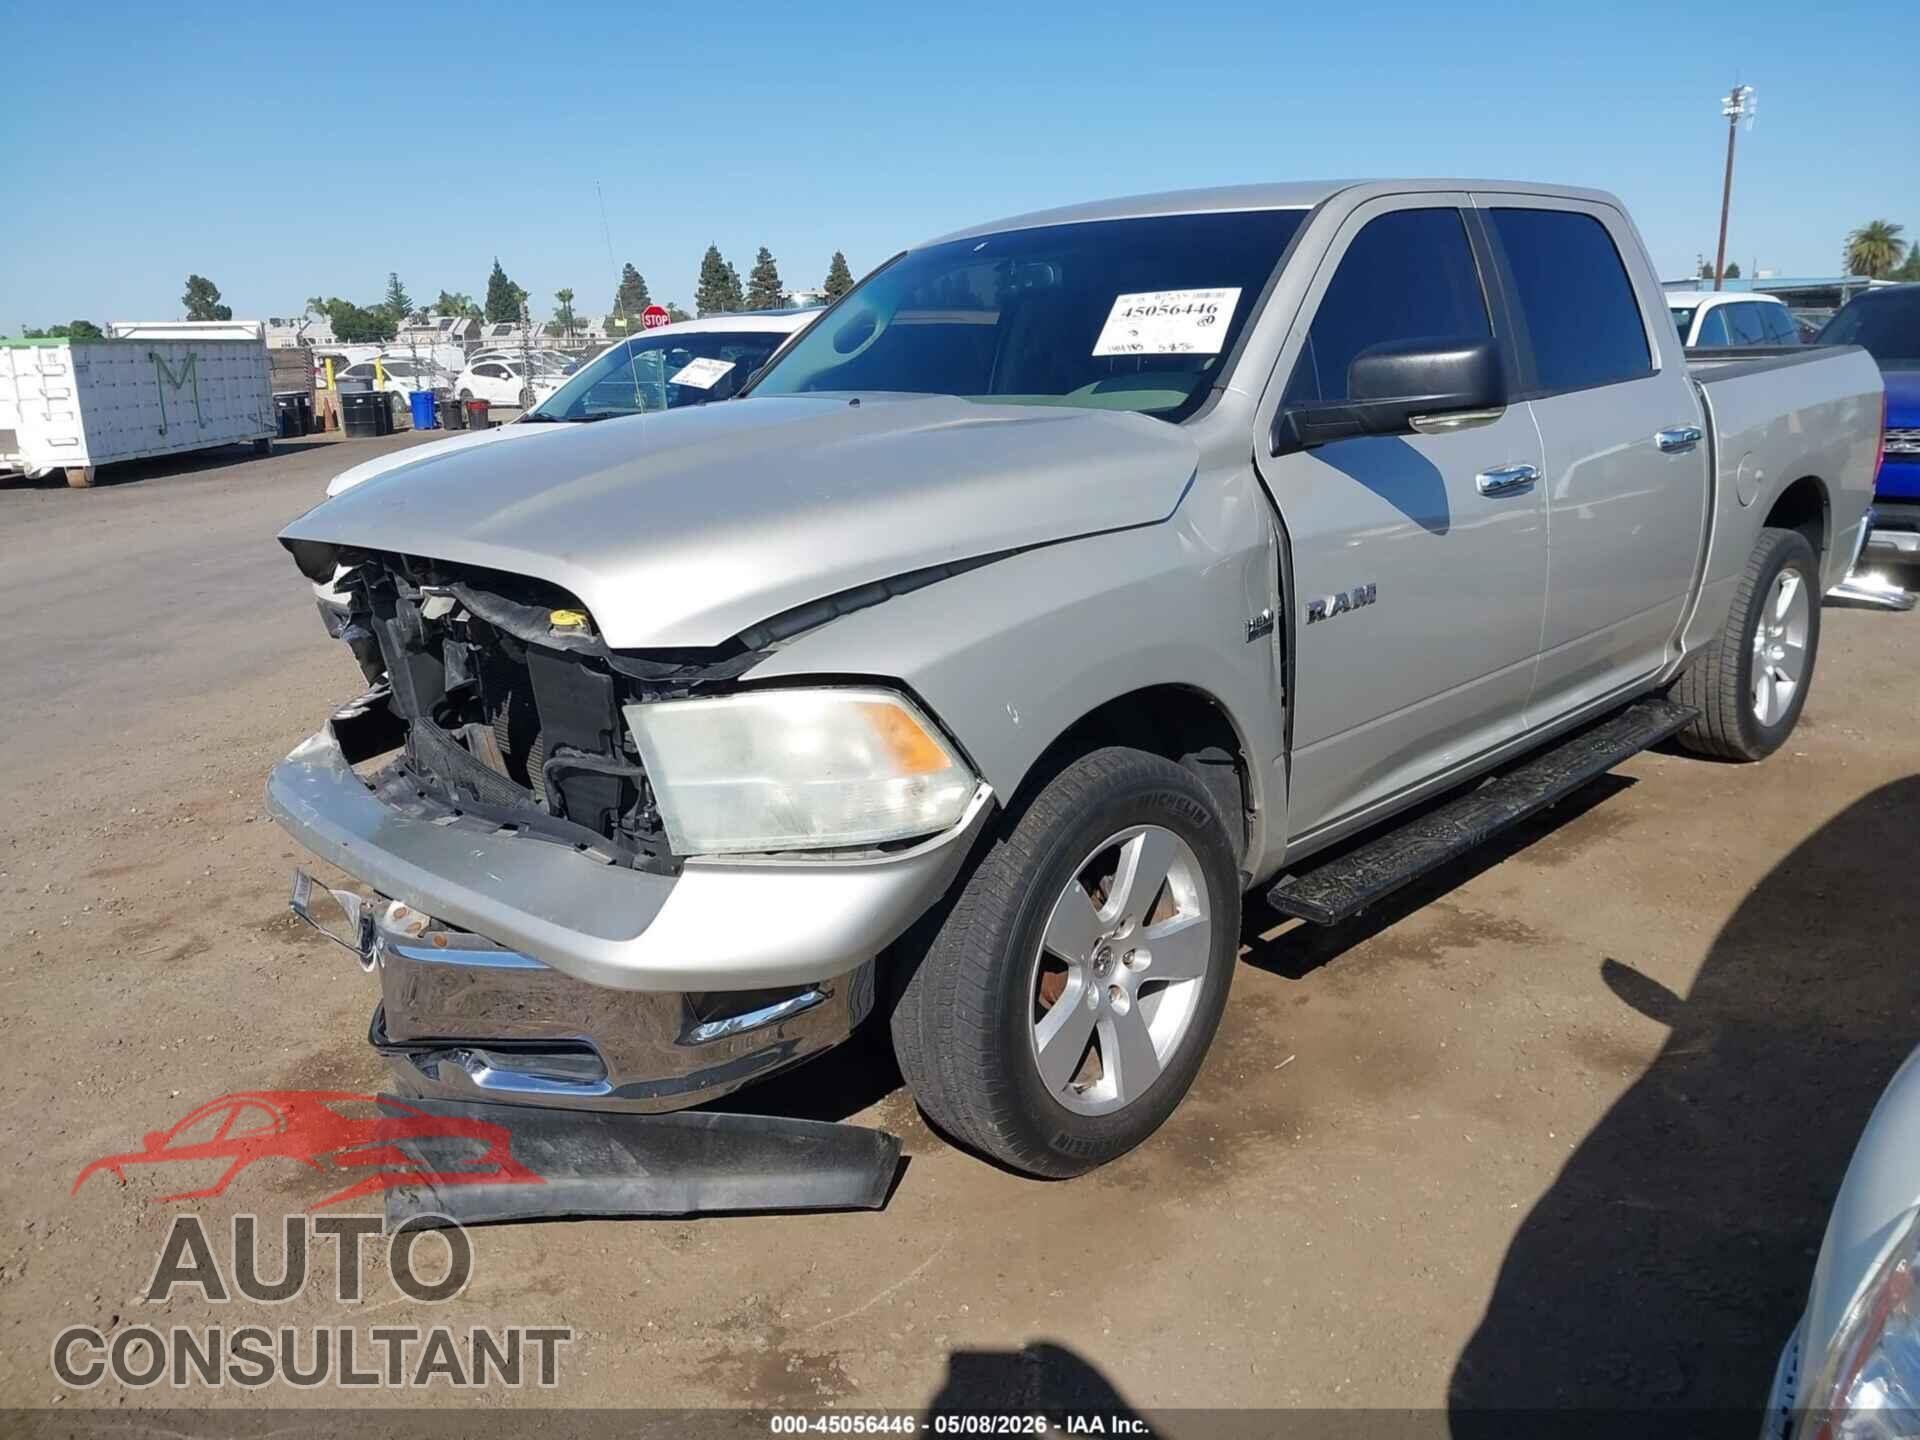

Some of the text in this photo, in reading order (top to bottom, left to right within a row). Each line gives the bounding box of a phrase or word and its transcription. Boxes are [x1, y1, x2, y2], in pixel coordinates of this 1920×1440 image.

[1121, 303, 1219, 318] 45056446
[645, 314, 668, 327] STOP
[1304, 582, 1378, 625] RAM
